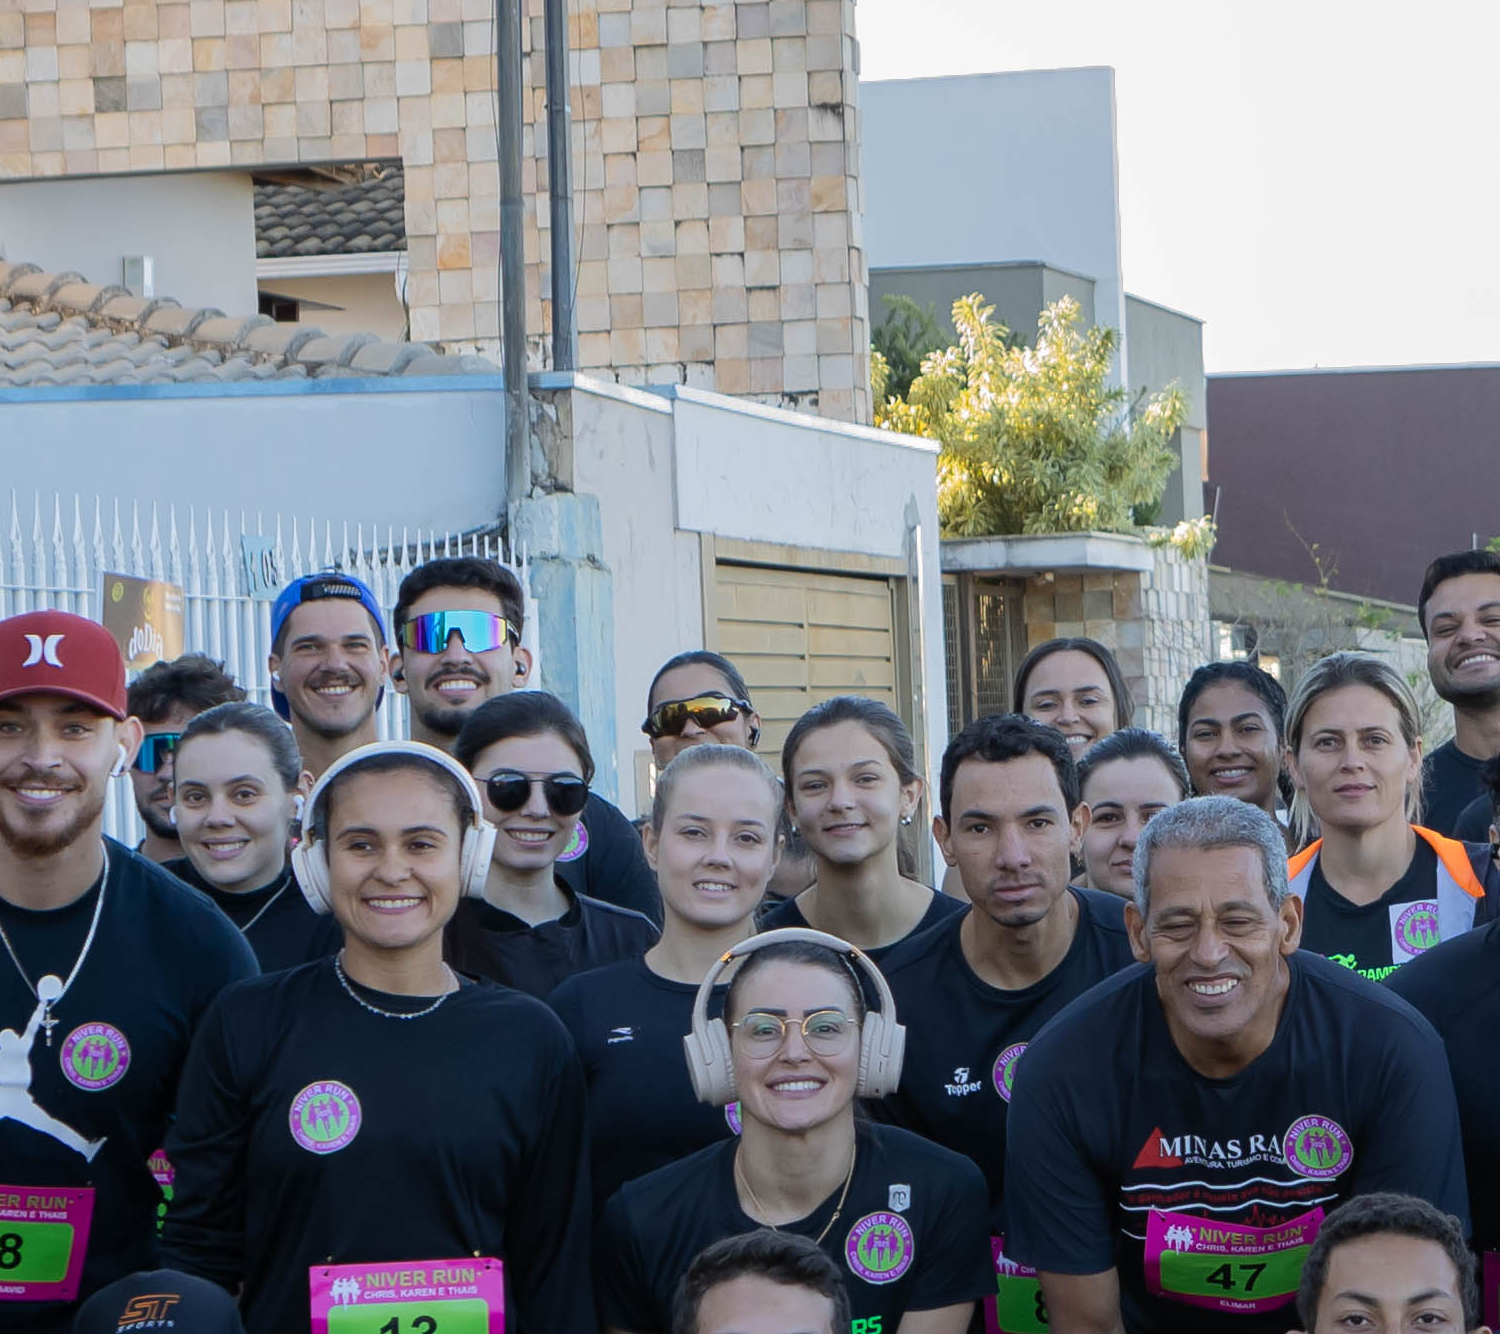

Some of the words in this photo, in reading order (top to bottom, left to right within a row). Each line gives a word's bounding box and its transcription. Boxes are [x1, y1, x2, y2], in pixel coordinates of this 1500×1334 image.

[944, 1080, 983, 1097] Topper
[1290, 1118, 1319, 1140] NIVER
[1321, 1118, 1343, 1139] RUN
[1159, 1134, 1241, 1161] MINAS
[1249, 1133, 1282, 1155] RA
[25, 1194, 67, 1210] RUN
[855, 1214, 888, 1236] NIVER
[1199, 1226, 1257, 1246] NIVER
[1262, 1225, 1303, 1245] RUN
[1230, 1243, 1266, 1253] KAREN
[365, 1270, 427, 1288] NIVER
[432, 1268, 476, 1285] RUN
[1205, 1263, 1267, 1292] 47
[400, 1287, 435, 1298] KAREN
[448, 1285, 479, 1296] THAIS
